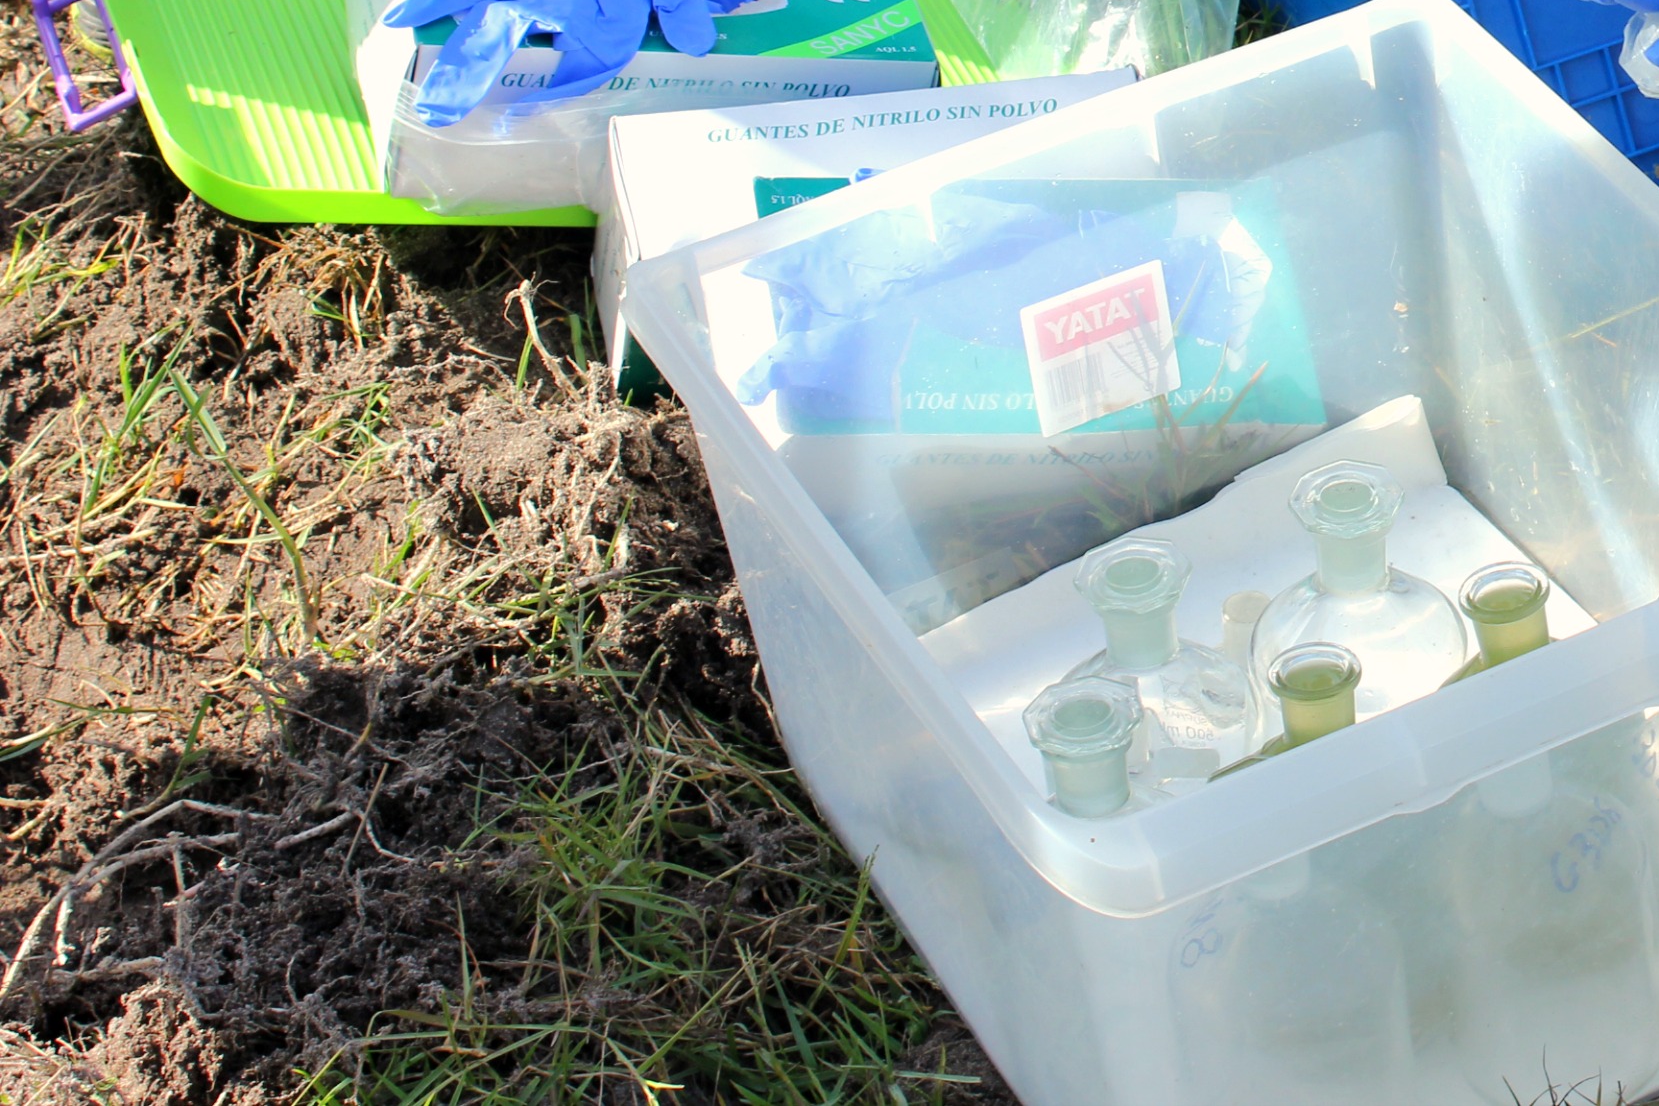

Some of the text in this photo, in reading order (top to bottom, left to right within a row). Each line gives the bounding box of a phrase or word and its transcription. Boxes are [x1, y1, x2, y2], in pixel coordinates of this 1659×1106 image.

[809, 9, 910, 56] SANYC
[875, 44, 917, 53] AQL 1.5
[608, 76, 641, 92] DE
[707, 97, 1059, 144] GUANTES DE NITRILO SIN POLVO
[964, 391, 1000, 411] SIN
